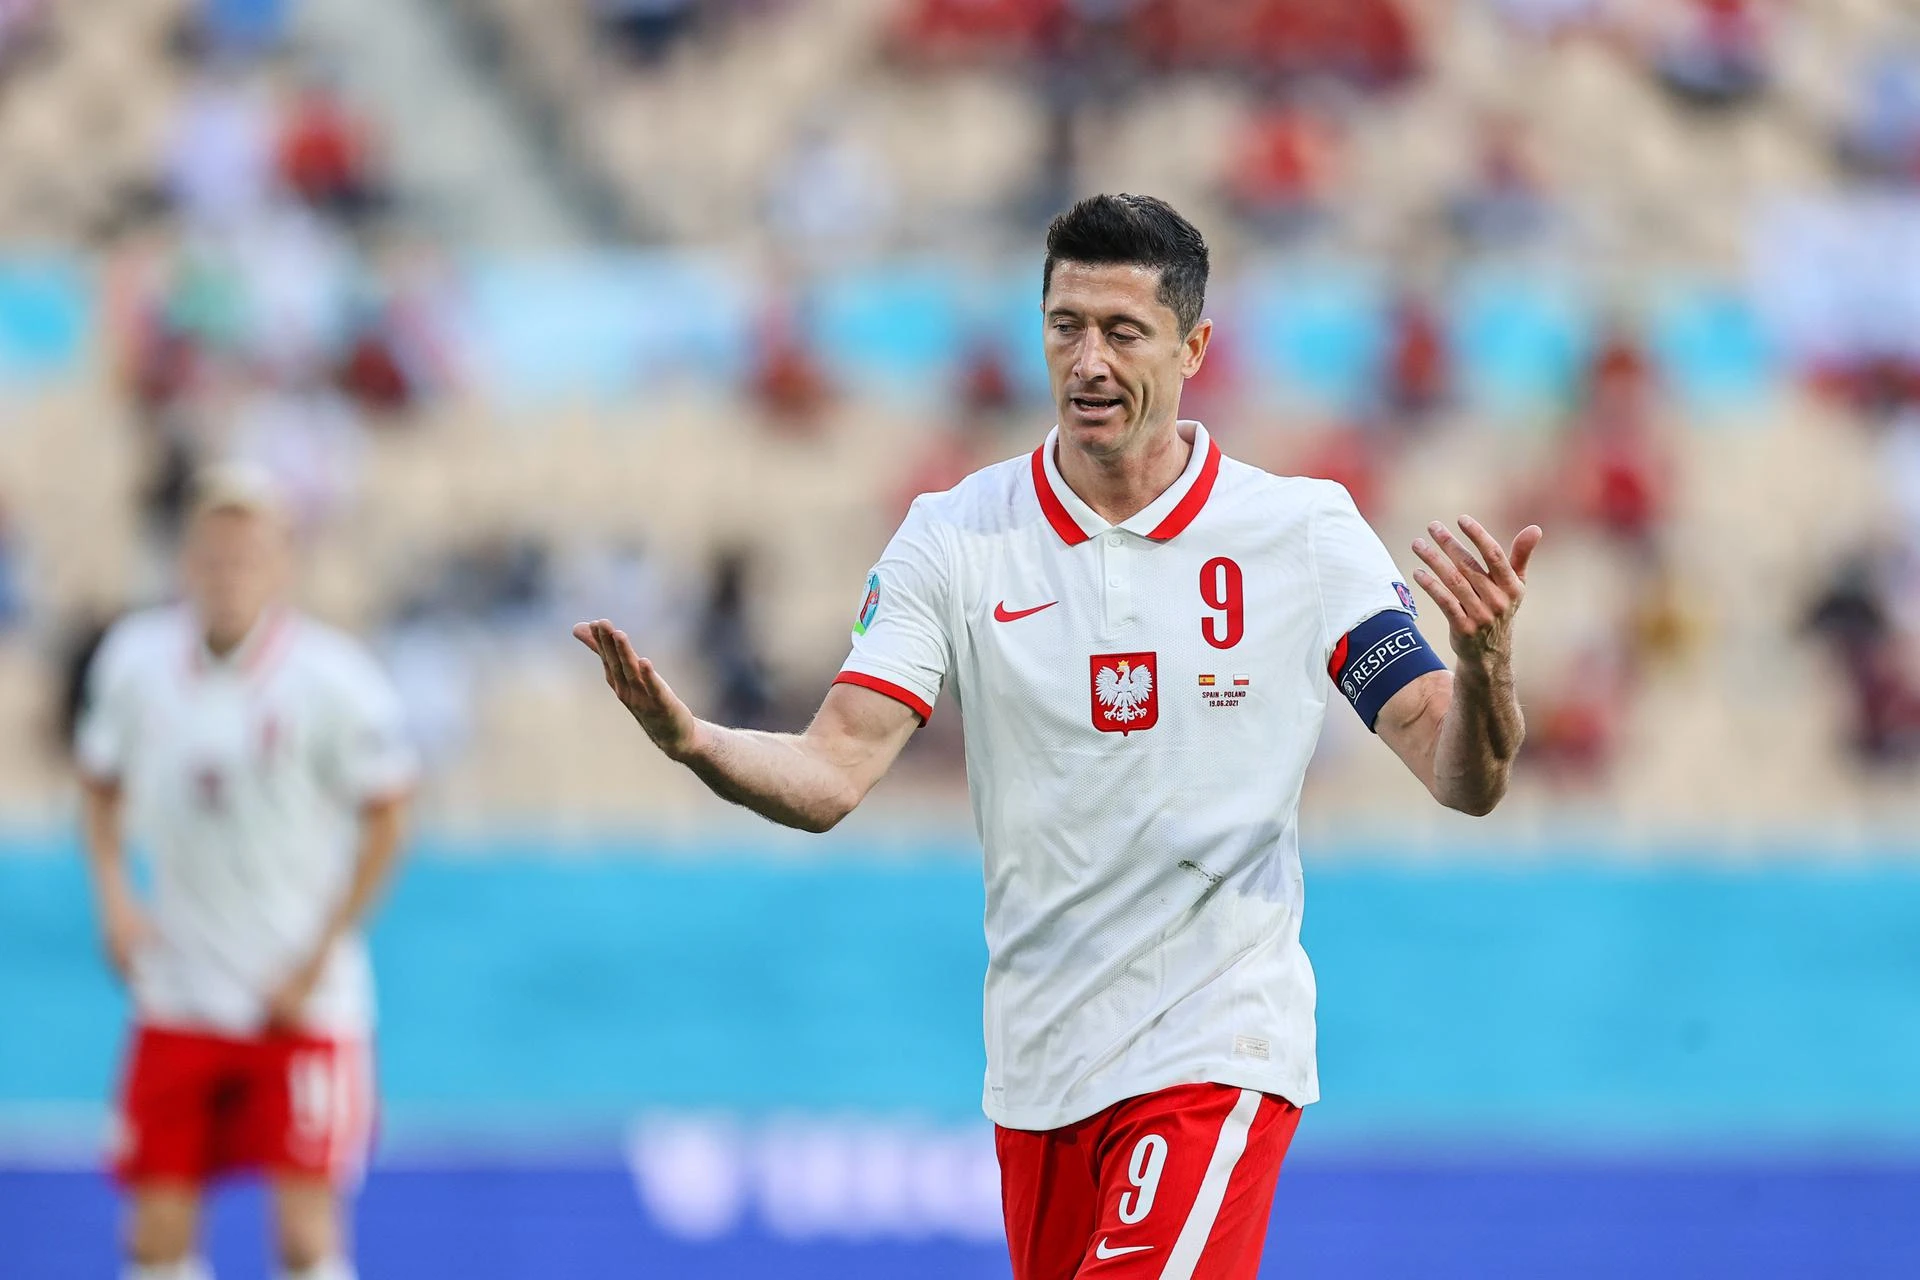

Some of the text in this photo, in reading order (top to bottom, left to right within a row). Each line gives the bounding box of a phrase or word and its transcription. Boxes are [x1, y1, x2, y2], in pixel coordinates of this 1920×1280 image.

[1199, 556, 1244, 650] 9
[1352, 631, 1417, 685] RESPECT
[1118, 1133, 1168, 1225] 9
